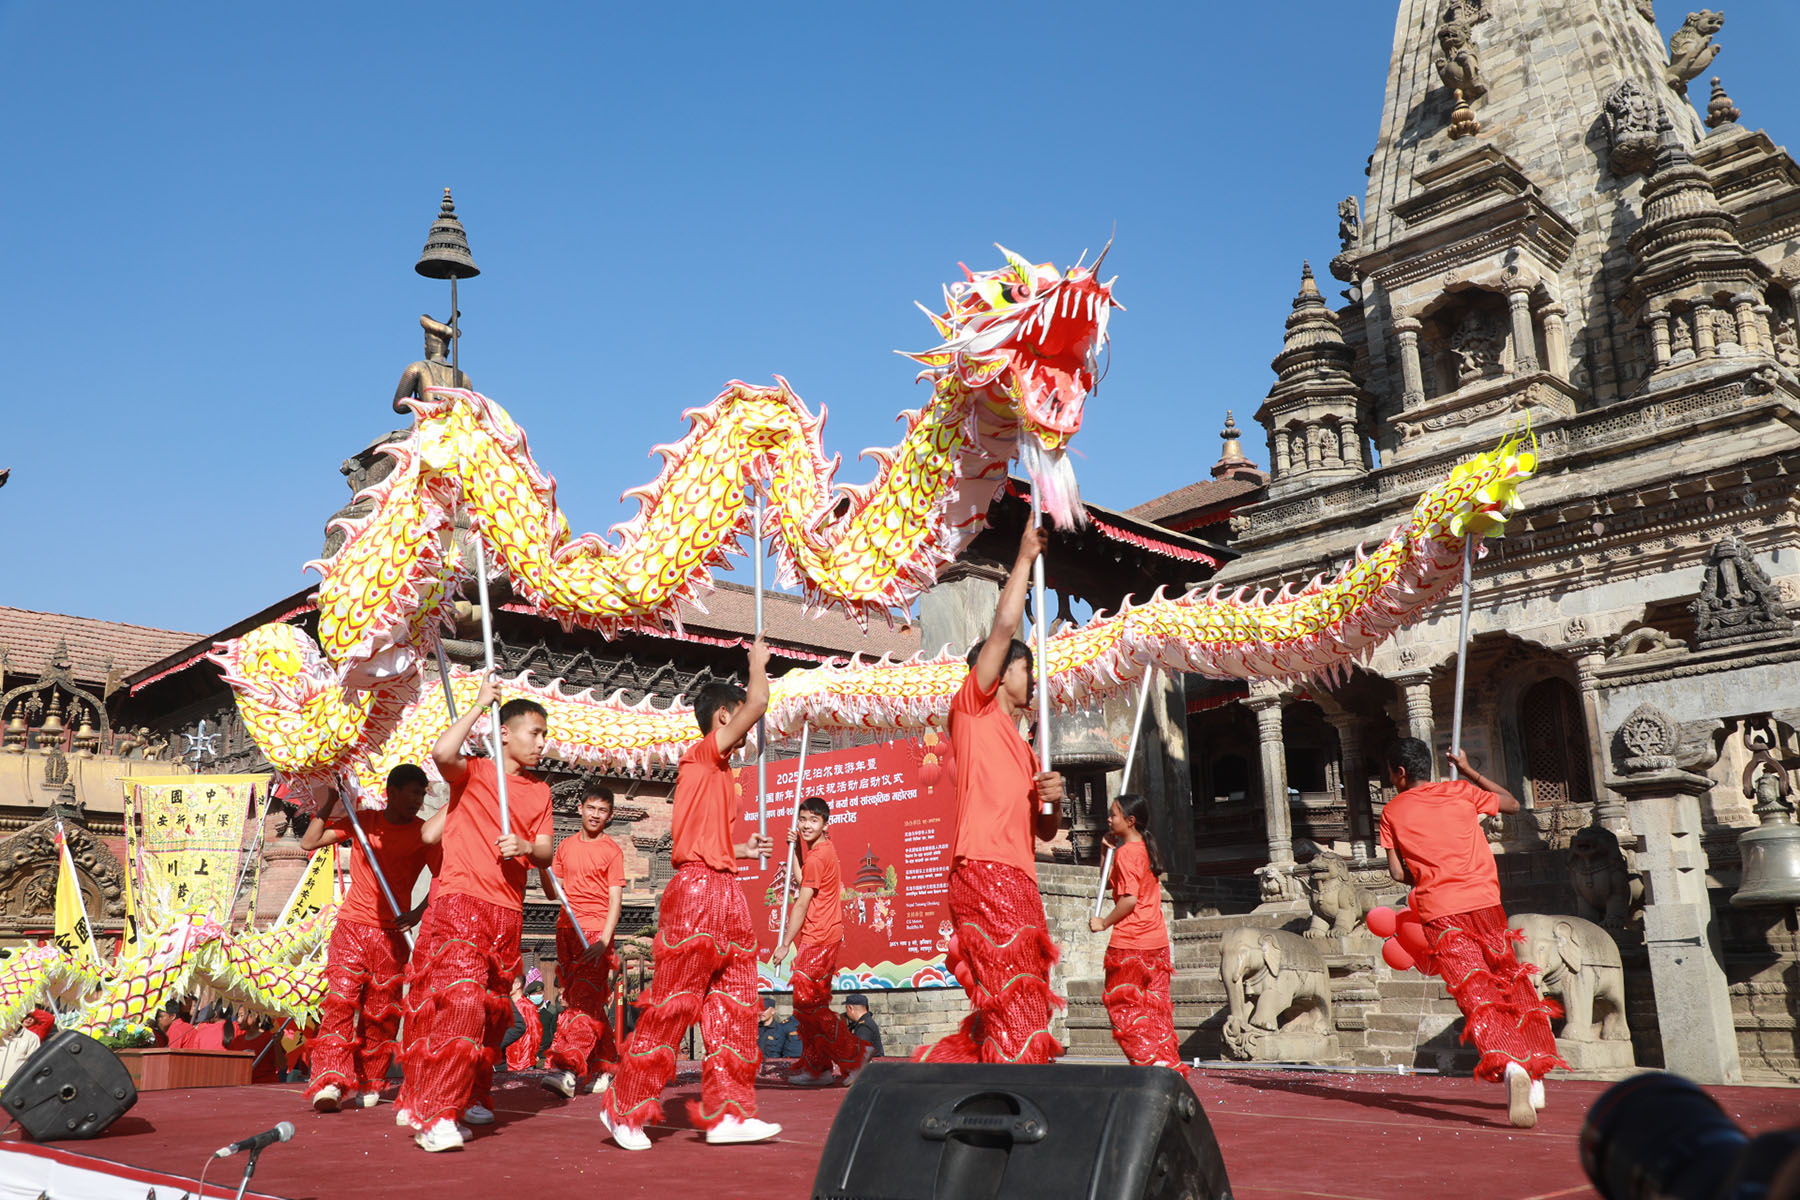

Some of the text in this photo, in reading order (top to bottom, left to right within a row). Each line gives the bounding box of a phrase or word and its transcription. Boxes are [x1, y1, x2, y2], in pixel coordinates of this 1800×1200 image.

[755, 773, 904, 803] 国新年列庆祝活动启动仪式
